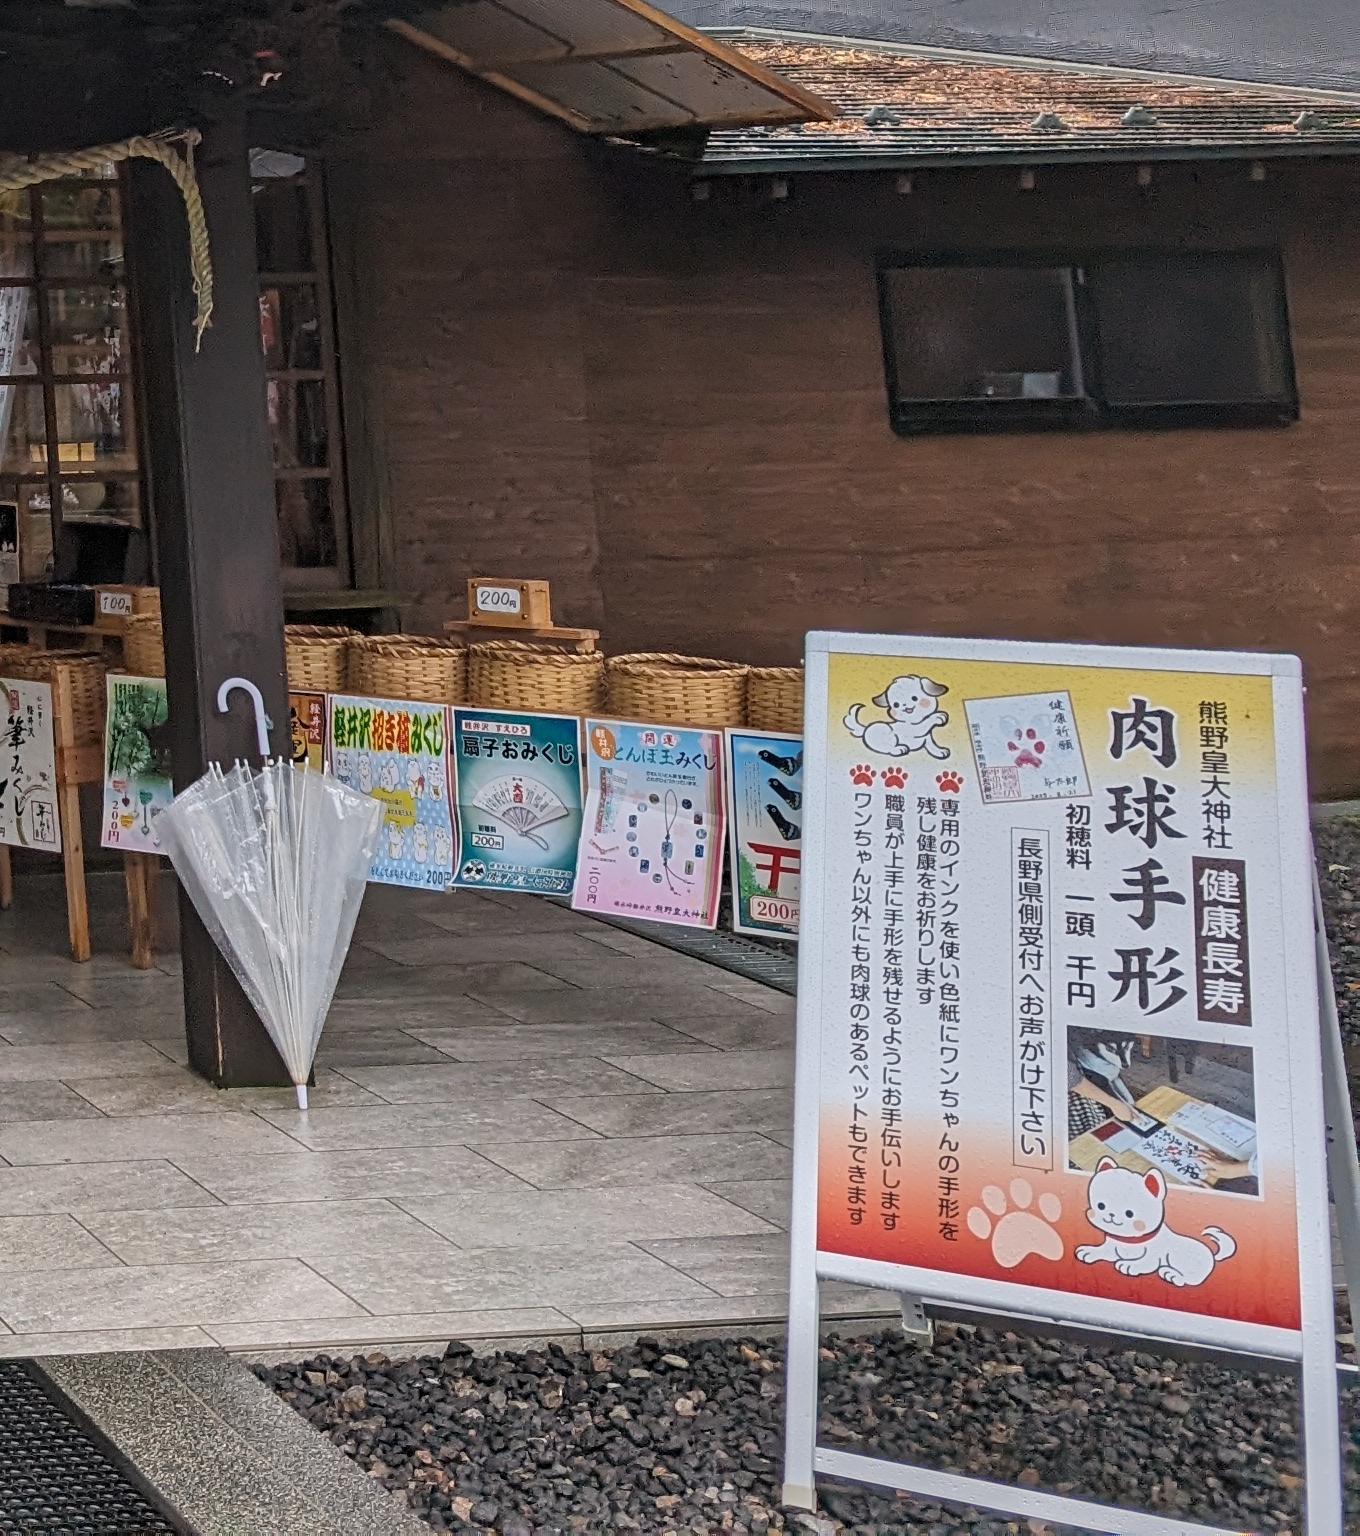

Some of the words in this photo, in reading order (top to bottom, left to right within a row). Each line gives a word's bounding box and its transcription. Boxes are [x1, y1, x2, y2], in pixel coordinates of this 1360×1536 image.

[103, 595, 131, 613] 100円
[480, 590, 517, 608] 200円
[309, 703, 322, 740] 軽井沢
[495, 724, 529, 735] すえひろ
[462, 735, 575, 765] 扇子おみくじ
[614, 747, 717, 771] とんぼ玉みくじ
[1198, 700, 1234, 850] 熊野皇大神社
[473, 835, 501, 848] 200円
[1065, 803, 1093, 871] 初穂料
[1103, 697, 1189, 1017] 肉球手形
[653, 904, 709, 920] 熊野皇大神社
[915, 796, 937, 1005] 残し健康をお祈りします
[1065, 893, 1097, 939] 一頭
[1198, 867, 1245, 1015] 健康長寿
[847, 792, 872, 1225] ワンちゃん以外にも肉球のあるペットもできます
[1017, 837, 1047, 1157] 長野県側受付へお声がけ下さい
[1065, 954, 1097, 1009] 千円
[880, 794, 906, 1231] 職員が上手に手形を残せるようにお手伝いします
[938, 798, 960, 1242] 専用のインクを使い色紙にワンちゃんの手形を
